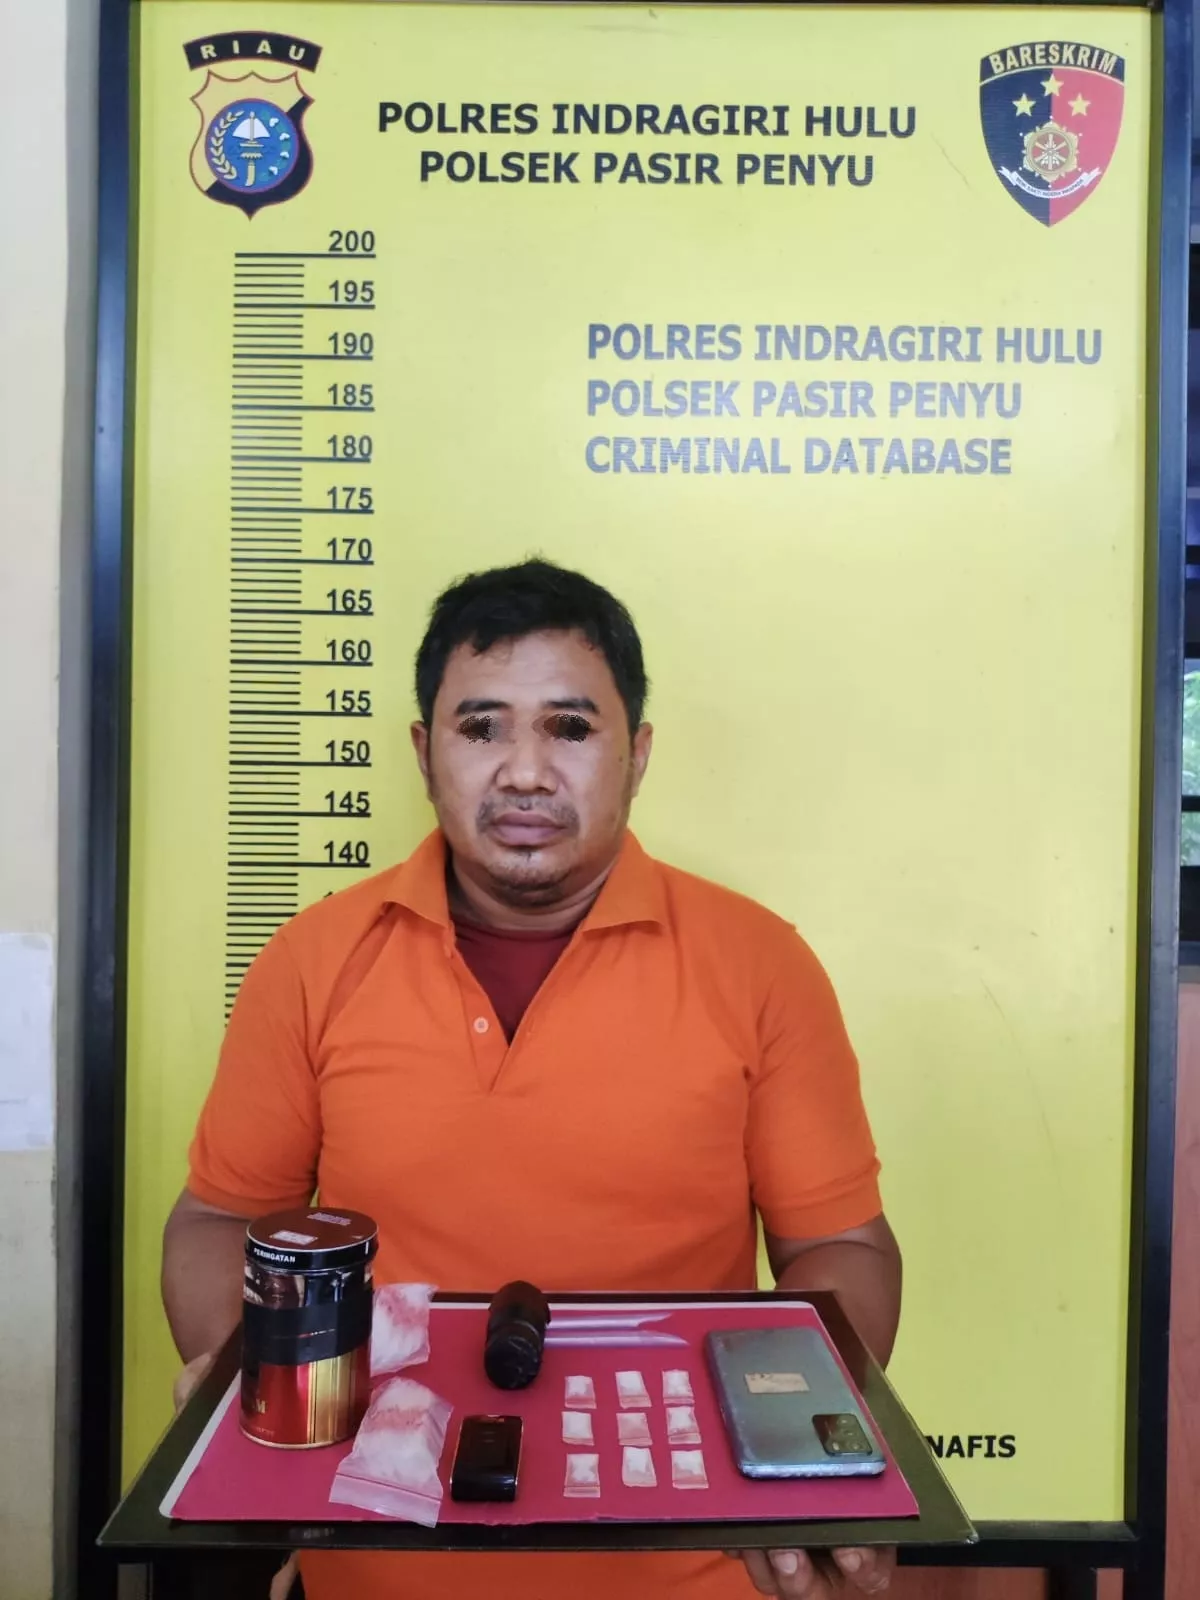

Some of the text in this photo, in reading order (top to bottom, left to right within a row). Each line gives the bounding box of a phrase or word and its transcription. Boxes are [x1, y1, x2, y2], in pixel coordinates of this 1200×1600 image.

[200, 39, 305, 61] RIAU
[989, 42, 1118, 75] BARESKRIM
[378, 102, 916, 138] POLRES INDRAGIRI HULU
[420, 151, 874, 187] POLSEK PASIR PENYU
[329, 230, 375, 253] 200
[329, 280, 374, 303] 195
[328, 331, 373, 355] 190
[588, 322, 1102, 364] POLRES INDRAGIRI HULU
[328, 383, 373, 406] 185
[587, 379, 1022, 419] POLSEK PASIR PENYU
[327, 434, 372, 458] 180
[585, 436, 1012, 475] CRIMINAL DATABASE
[327, 486, 372, 509] 175
[327, 537, 372, 560] 170
[327, 589, 372, 611] 165
[326, 639, 371, 661] 160
[326, 689, 371, 712] 155
[325, 740, 370, 762] 150
[325, 790, 370, 812] 145
[324, 840, 369, 863] 140
